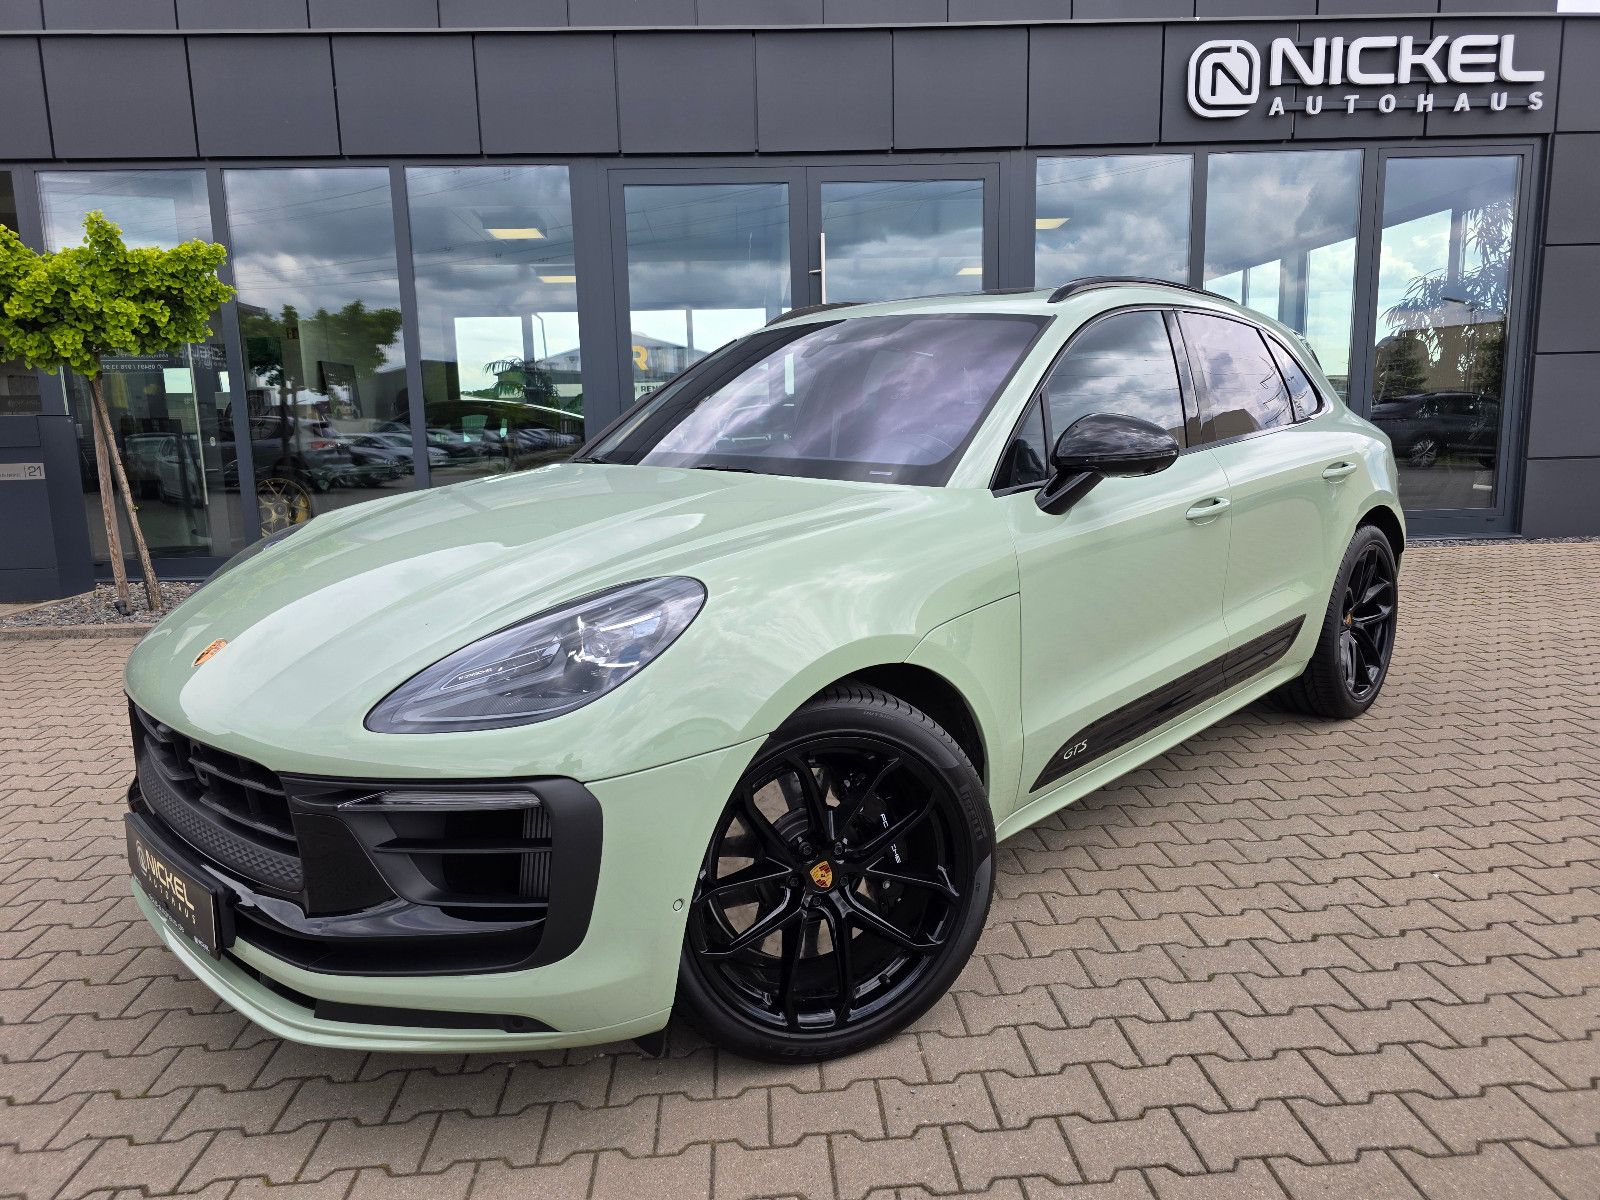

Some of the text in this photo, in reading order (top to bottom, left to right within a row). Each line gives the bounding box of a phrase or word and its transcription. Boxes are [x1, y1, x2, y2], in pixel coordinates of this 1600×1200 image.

[1269, 34, 1545, 86] NICKEL
[1268, 91, 1544, 116] AUTOHAUS
[27, 465, 42, 477] 21
[1063, 738, 1088, 760] GTS
[145, 849, 195, 911] NICKEL
